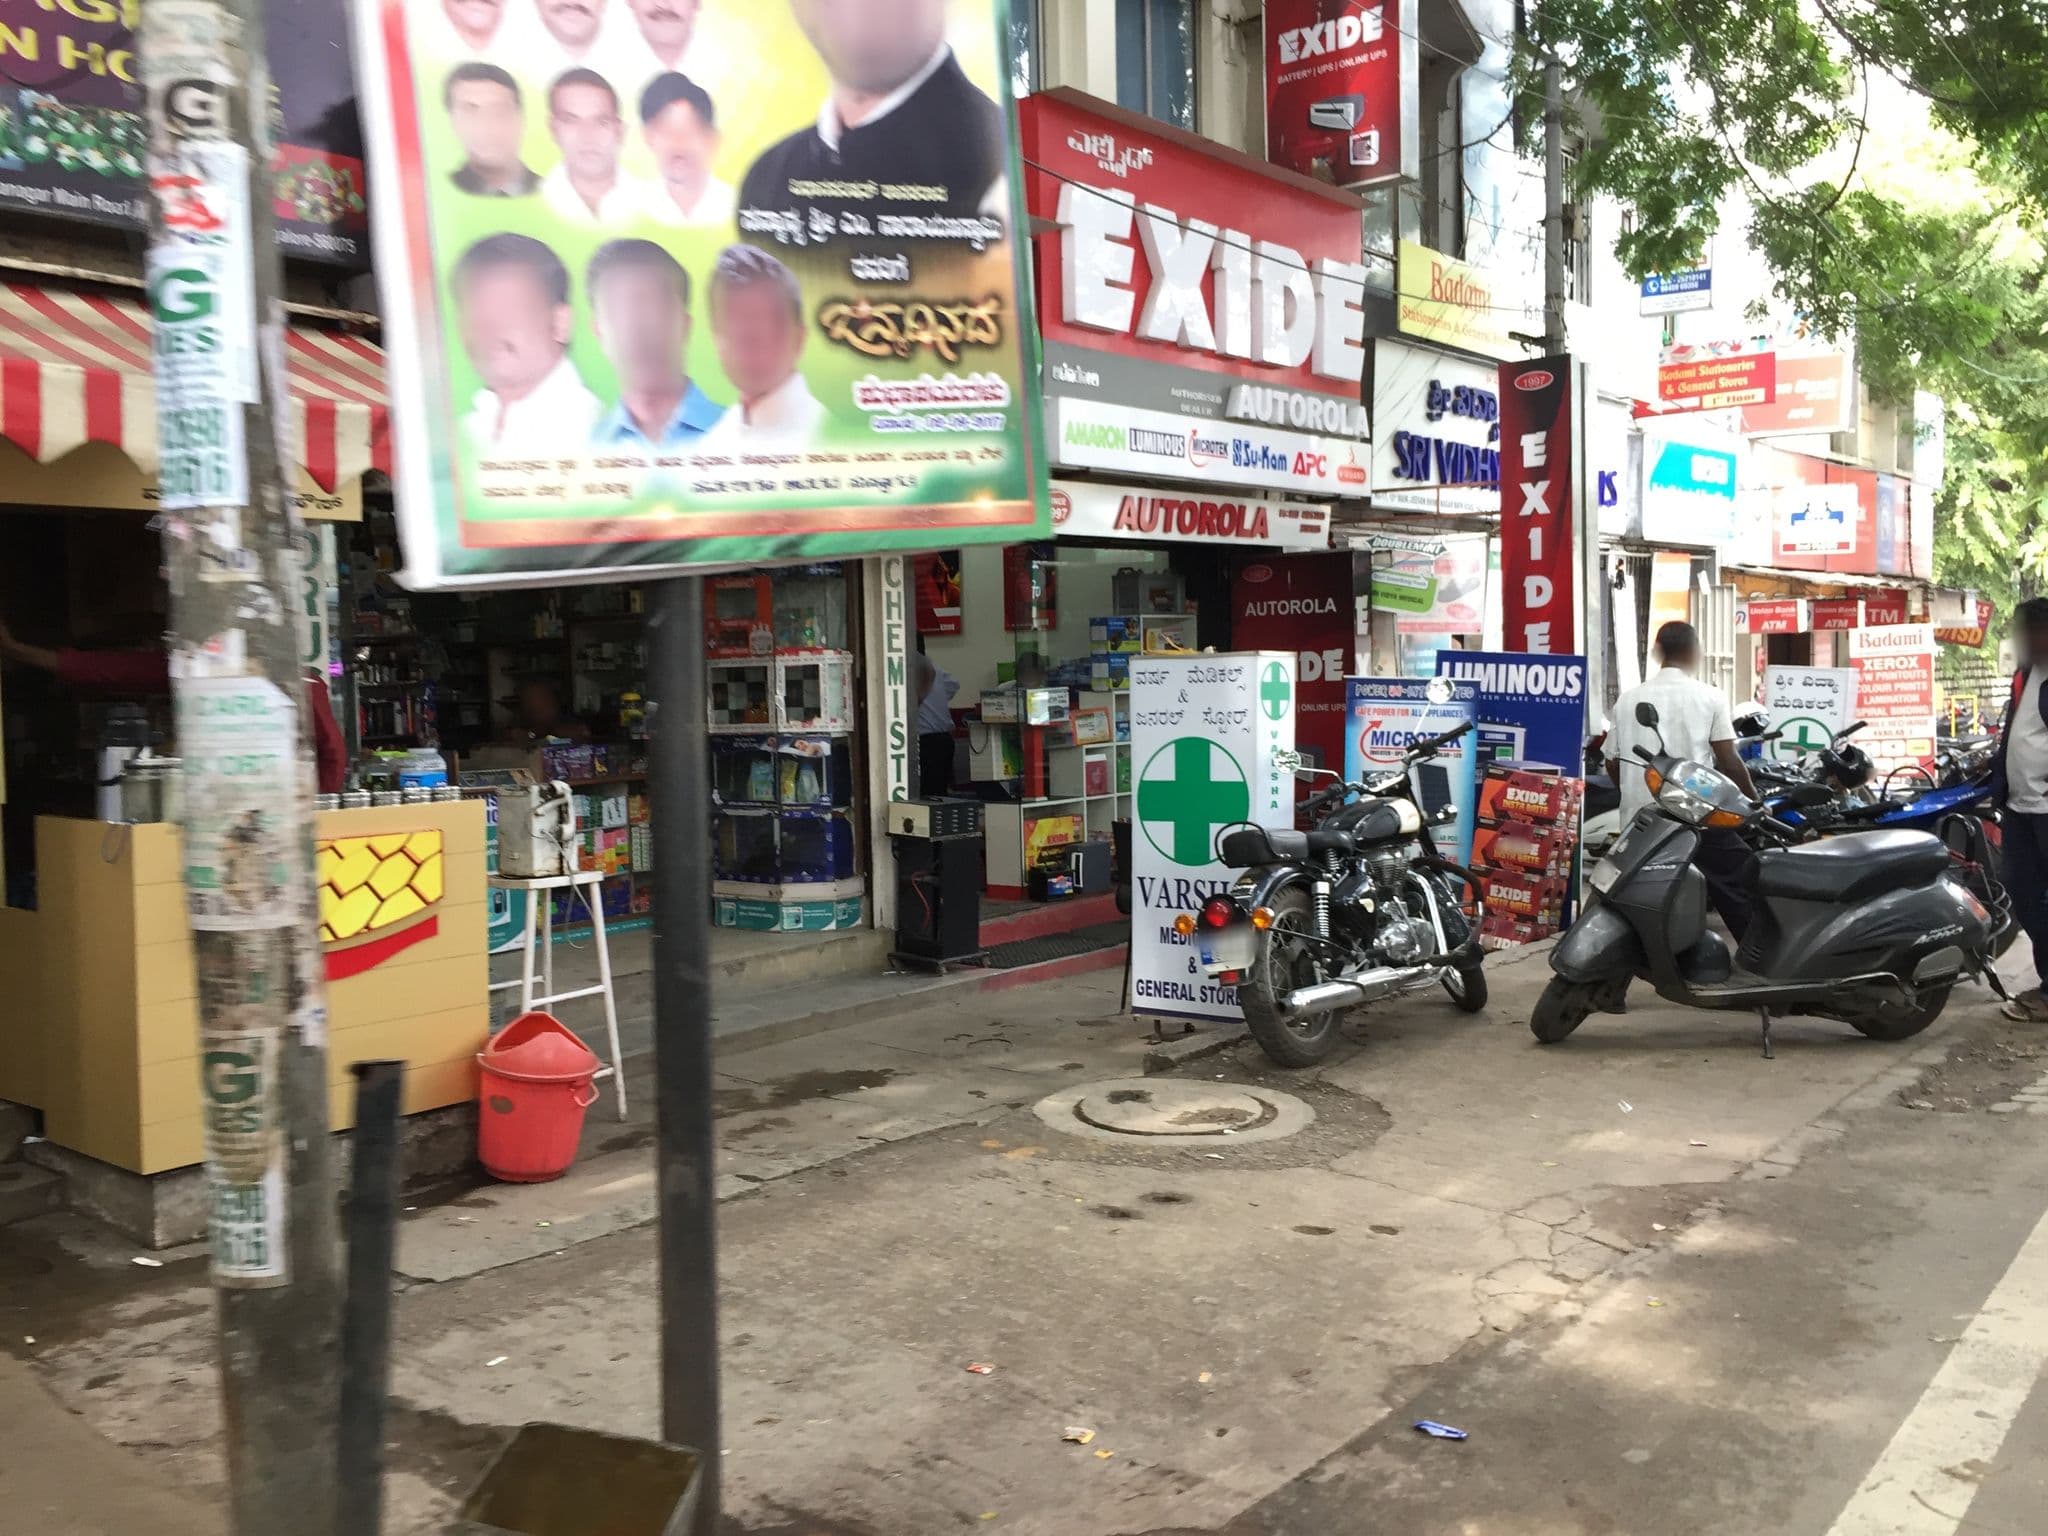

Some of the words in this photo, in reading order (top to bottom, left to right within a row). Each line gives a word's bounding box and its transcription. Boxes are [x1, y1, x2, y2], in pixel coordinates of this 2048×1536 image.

[1278, 5, 1383, 64] EXIDE
[1277, 68, 1313, 85] BATTERY
[1317, 62, 1335, 75] UPS
[1339, 52, 1369, 69] ONLINE
[1370, 48, 1388, 60] UPS
[1056, 180, 1368, 382] EXIDE
[1431, 260, 1491, 316] Badami
[1698, 360, 1756, 377] Stationeries
[1522, 375, 1546, 388] 1997
[1678, 379, 1716, 393] General
[1718, 376, 1749, 388] Stores
[1225, 383, 1371, 440] AUTOROLA
[1065, 419, 1126, 452] AMARON
[1130, 428, 1185, 458] LUMINOUS
[1243, 440, 1288, 473] Su-Kam
[1292, 451, 1327, 478] APC
[1392, 430, 1431, 483] SRI
[1113, 495, 1269, 538] AUTOROLA
[1373, 538, 1442, 554] DOUBLEMINT
[1518, 430, 1555, 655] EXIDE
[1245, 597, 1337, 617] AUTOROLA
[1750, 607, 1773, 615] Union
[1775, 605, 1796, 613] Bank
[1868, 608, 1899, 623] TM
[1761, 621, 1787, 631] ATM
[1824, 619, 1848, 629] ATM
[1859, 629, 1923, 649] Badami
[1297, 648, 1345, 682] DE
[1862, 656, 1919, 670] XEROX
[1442, 662, 1582, 697] LUMINOUS
[1300, 703, 1329, 713] ONLINE
[1331, 703, 1346, 712] UPS
[1507, 788, 1549, 805] EXIDE
[1046, 835, 1069, 845] EXIDE
[1490, 885, 1532, 903] EXIDE
[1188, 956, 1198, 974] &
[1136, 979, 1196, 1001] GENERAL
[1200, 985, 1240, 1006] STOR
